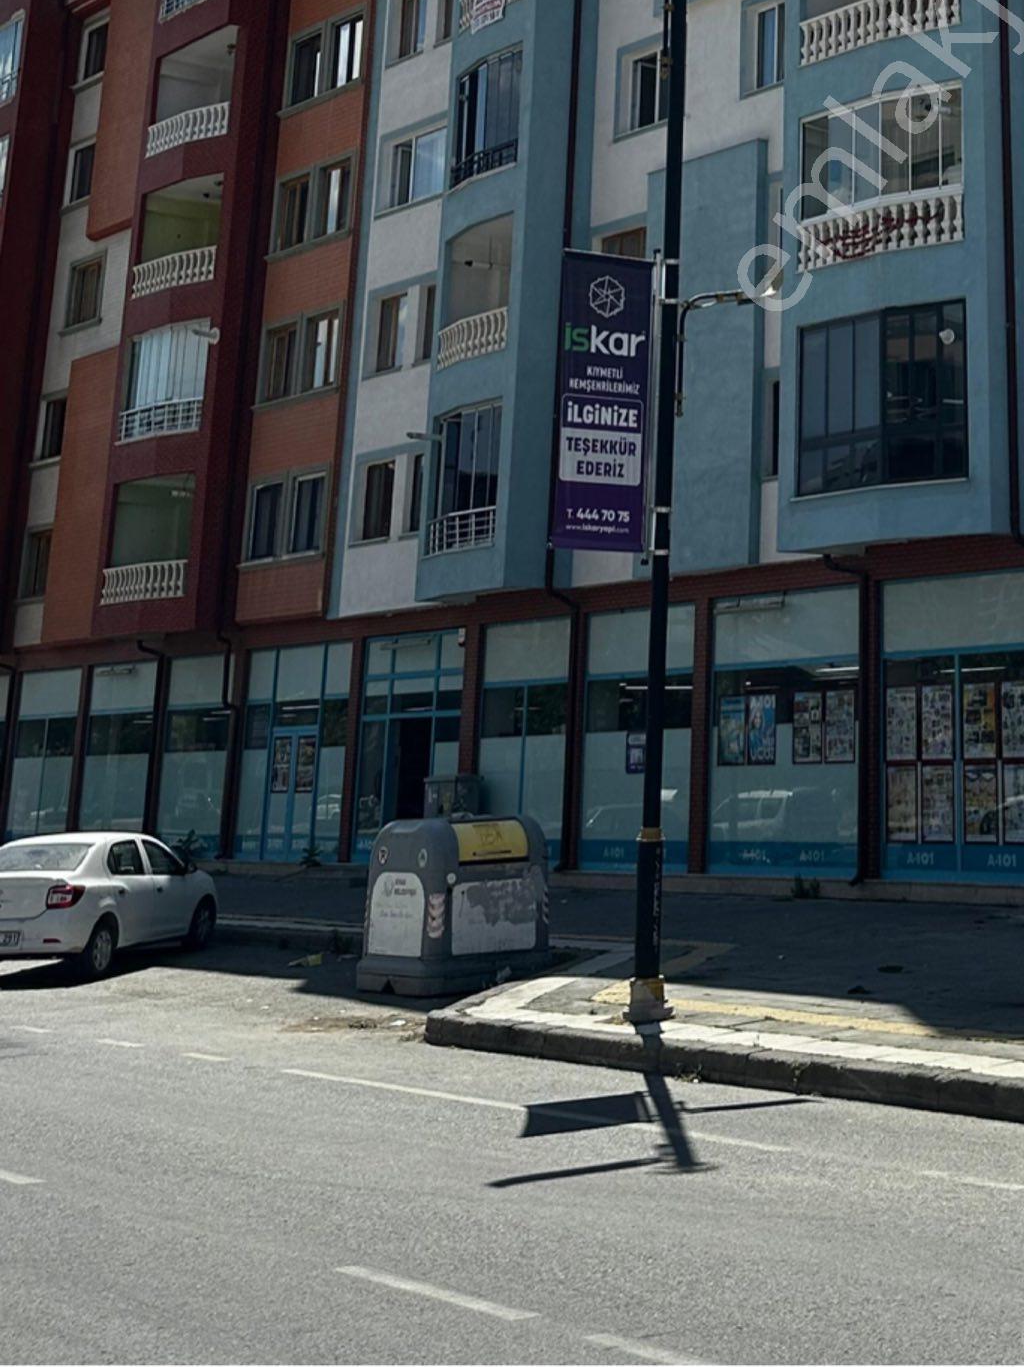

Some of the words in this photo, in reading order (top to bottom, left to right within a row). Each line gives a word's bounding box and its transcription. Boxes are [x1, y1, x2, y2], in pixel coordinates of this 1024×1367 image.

[586, 365, 624, 379] KIYMETLİ
[567, 401, 638, 427] İLGİNİZE
[566, 436, 636, 456] TEŞEKKÜR
[577, 459, 625, 478] EDERİZ
[576, 508, 599, 521] 444
[601, 509, 615, 522] 70
[617, 510, 630, 523] 75
